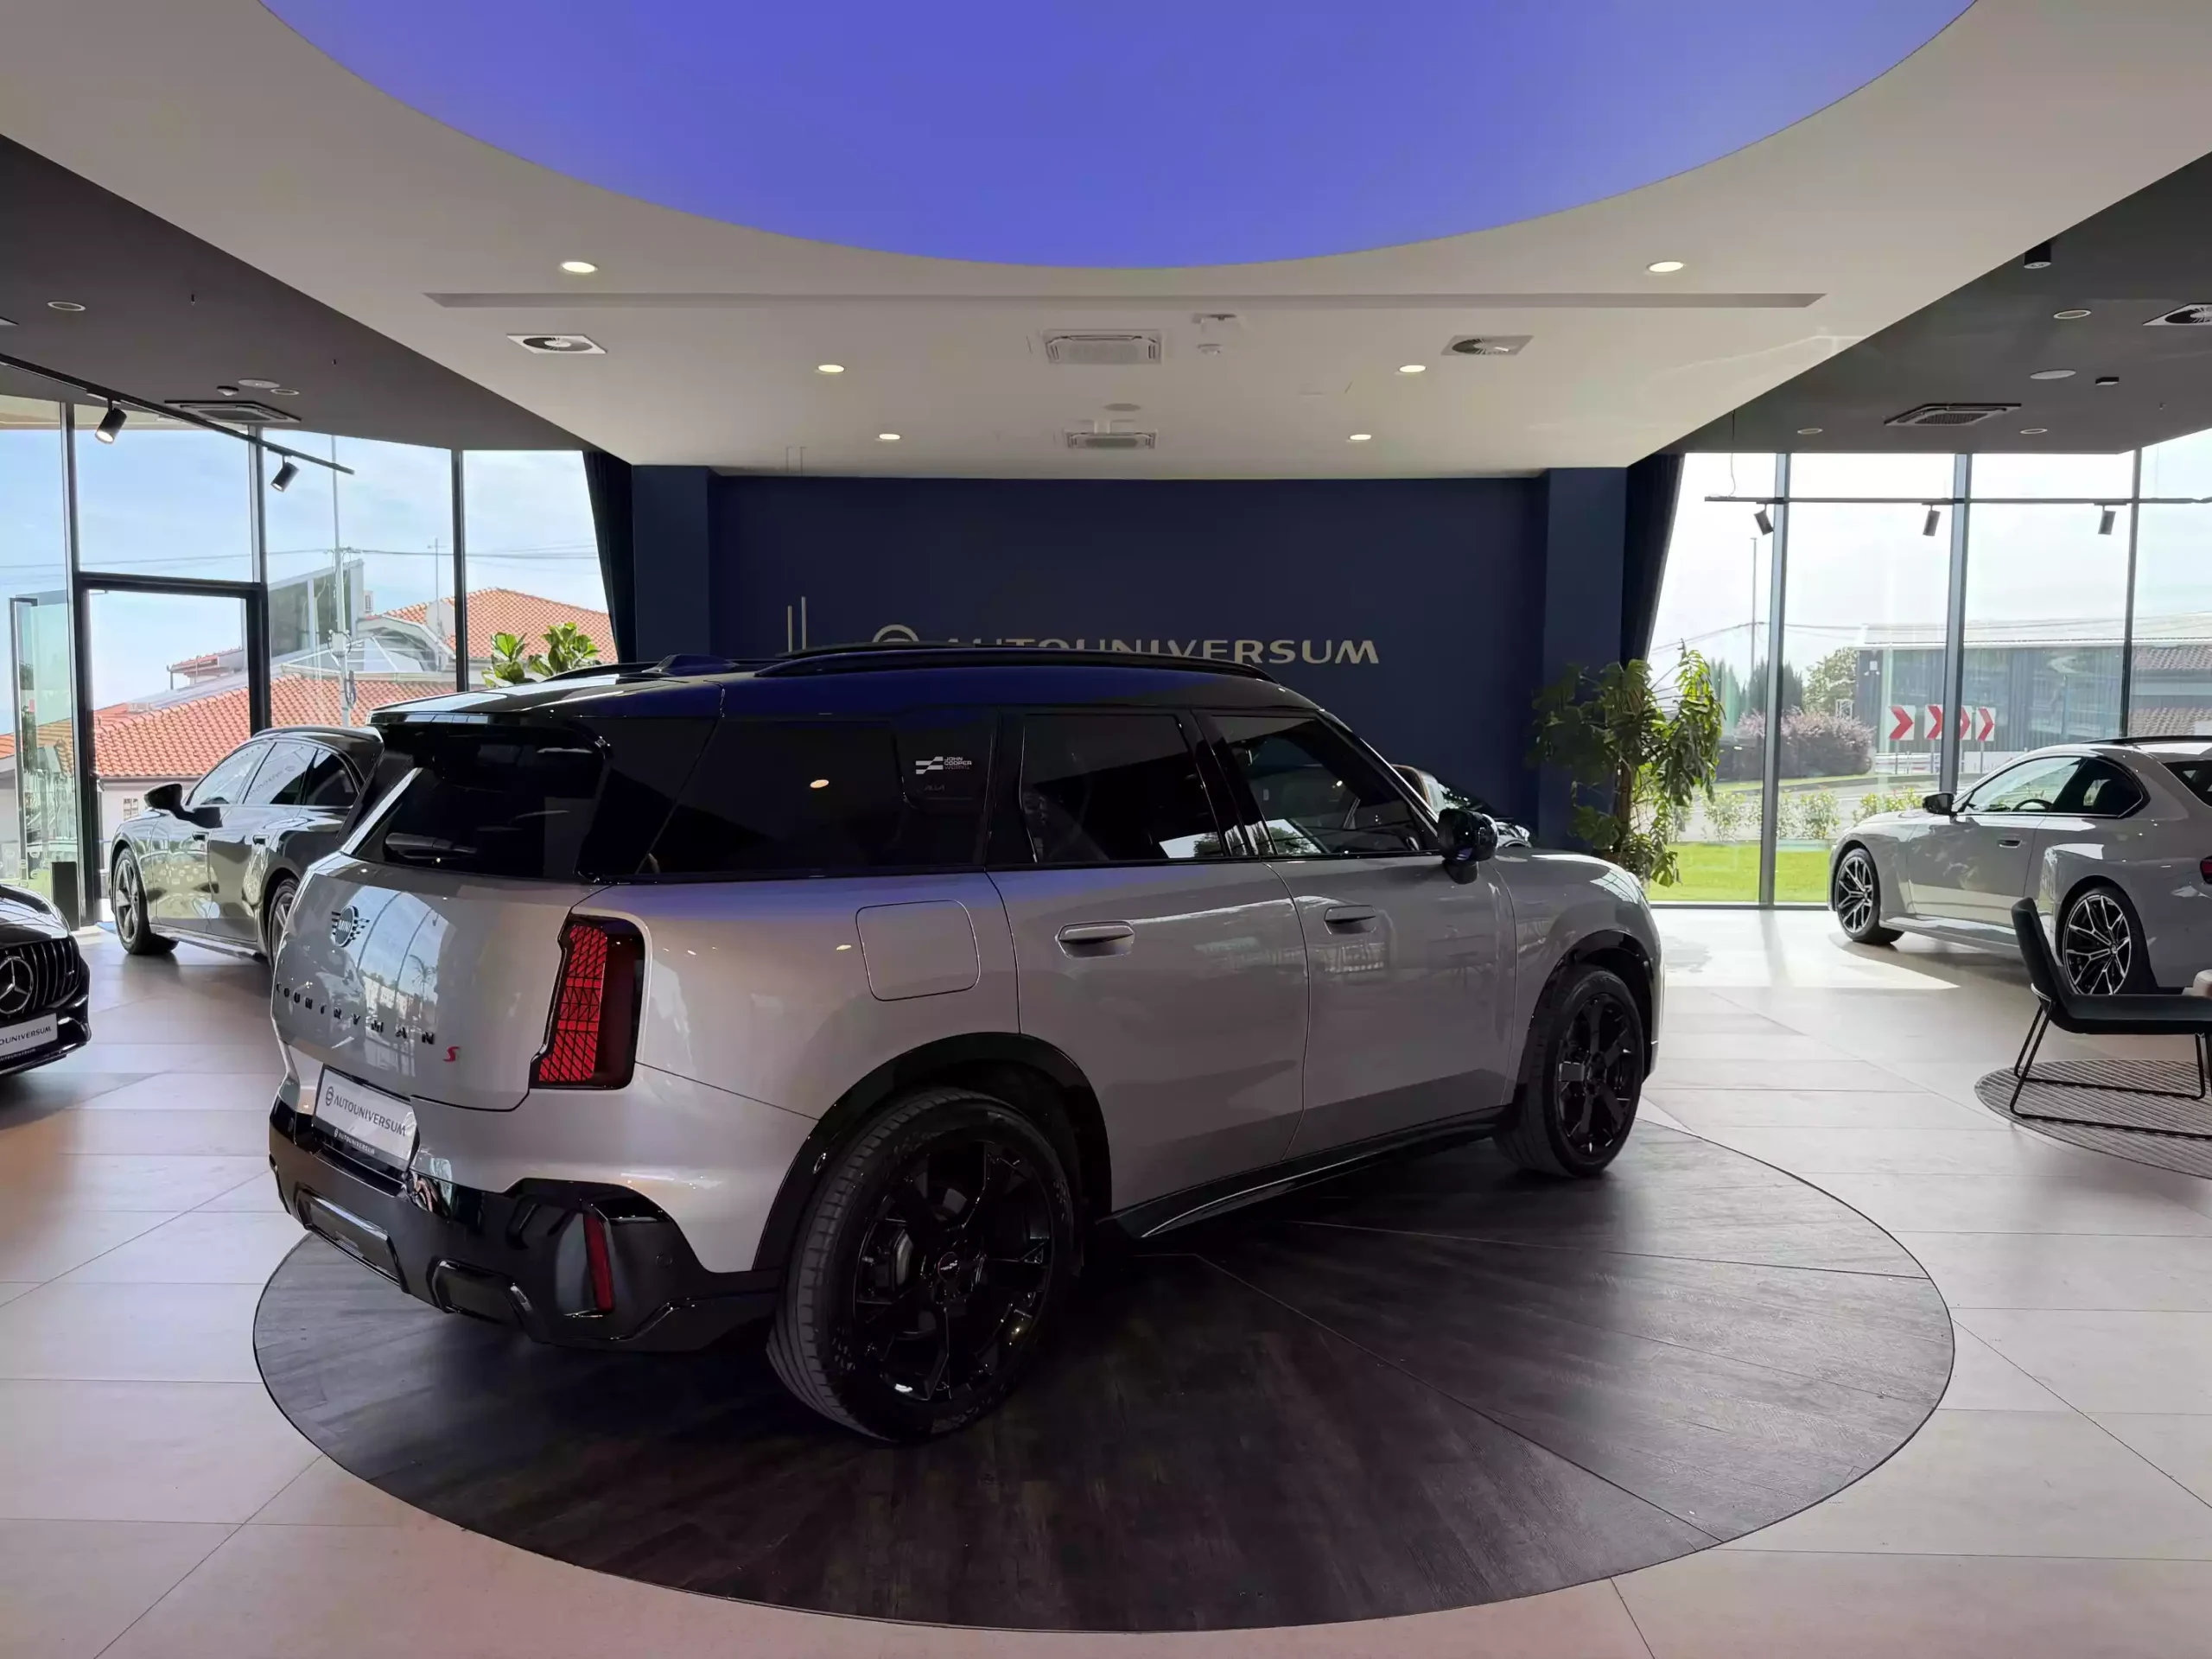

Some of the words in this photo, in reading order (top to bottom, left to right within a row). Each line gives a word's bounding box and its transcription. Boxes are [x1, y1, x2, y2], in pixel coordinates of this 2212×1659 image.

[337, 919, 352, 932] MINI
[276, 982, 435, 1046] COUNTRYMAN
[442, 1046, 461, 1063] S
[334, 1095, 407, 1137] AUTOUNIVERSUM
